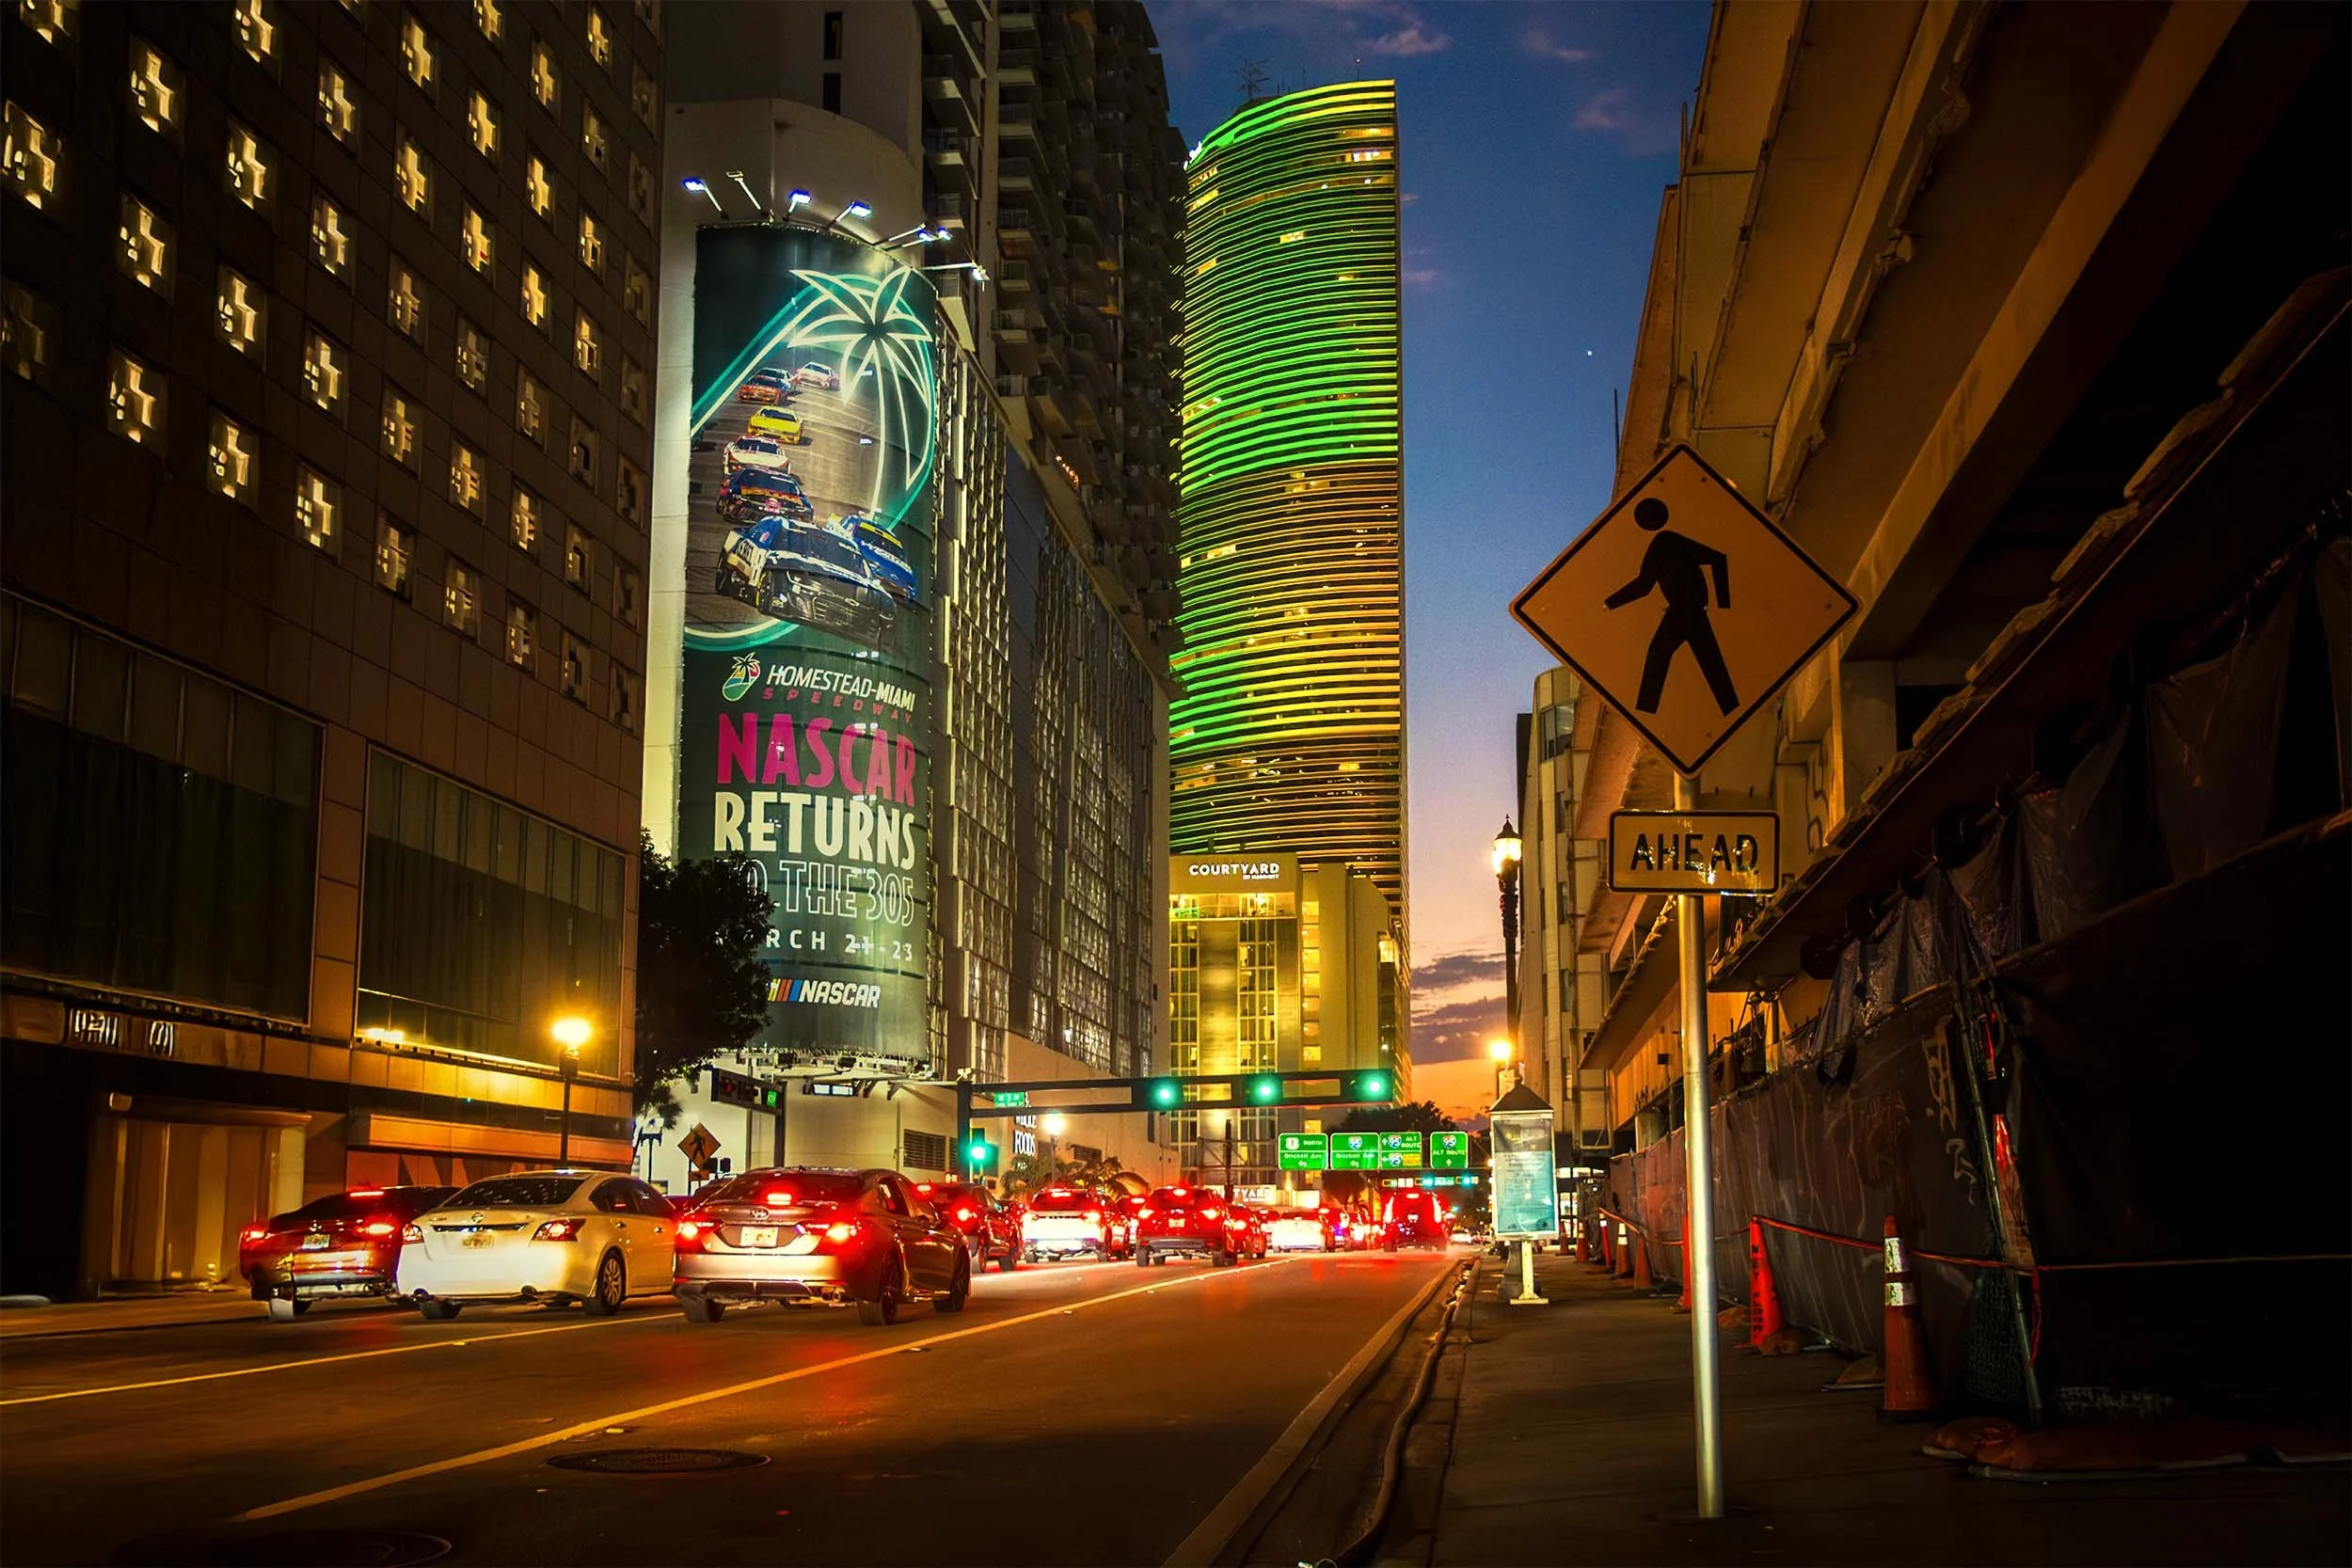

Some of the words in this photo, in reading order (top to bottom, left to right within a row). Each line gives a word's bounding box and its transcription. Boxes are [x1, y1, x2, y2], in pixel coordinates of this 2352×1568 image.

[762, 688, 913, 724] SPEEDWAY
[767, 664, 916, 712] HOMESTEAD-MIAMI
[717, 712, 916, 808] NASCAR
[714, 791, 915, 870] RETURNS
[1188, 863, 1279, 876] COURTYARD
[1630, 833, 1758, 872] AHEAD
[779, 860, 857, 918] THE
[866, 867, 915, 927] 305
[800, 980, 882, 1009] NASCAR
[1015, 1130, 1039, 1158] FOODS
